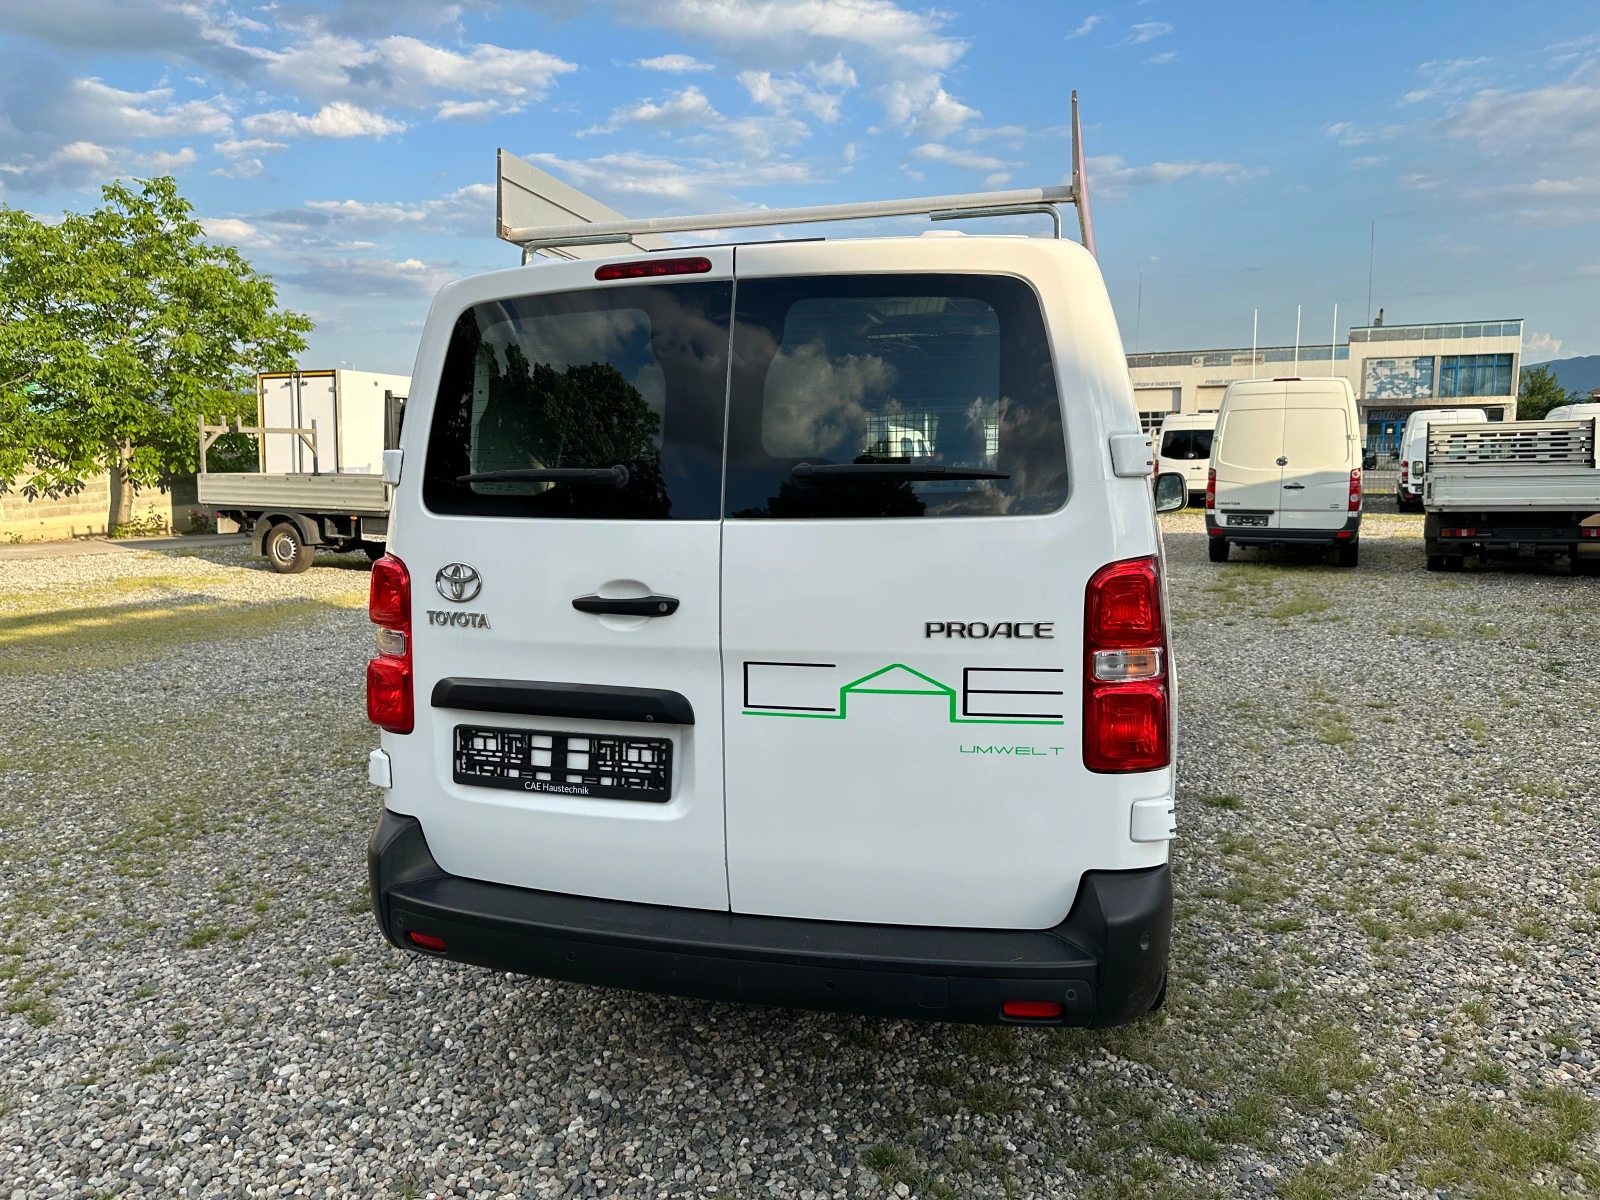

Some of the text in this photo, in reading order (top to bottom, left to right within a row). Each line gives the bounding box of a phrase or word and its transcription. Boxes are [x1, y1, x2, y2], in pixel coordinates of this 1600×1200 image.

[426, 610, 491, 629] TOYOTA
[925, 621, 1055, 639] PROACE
[742, 661, 1064, 725] CAE
[959, 744, 1065, 756] UMWELT
[524, 781, 590, 795] CAE Haustechnik
